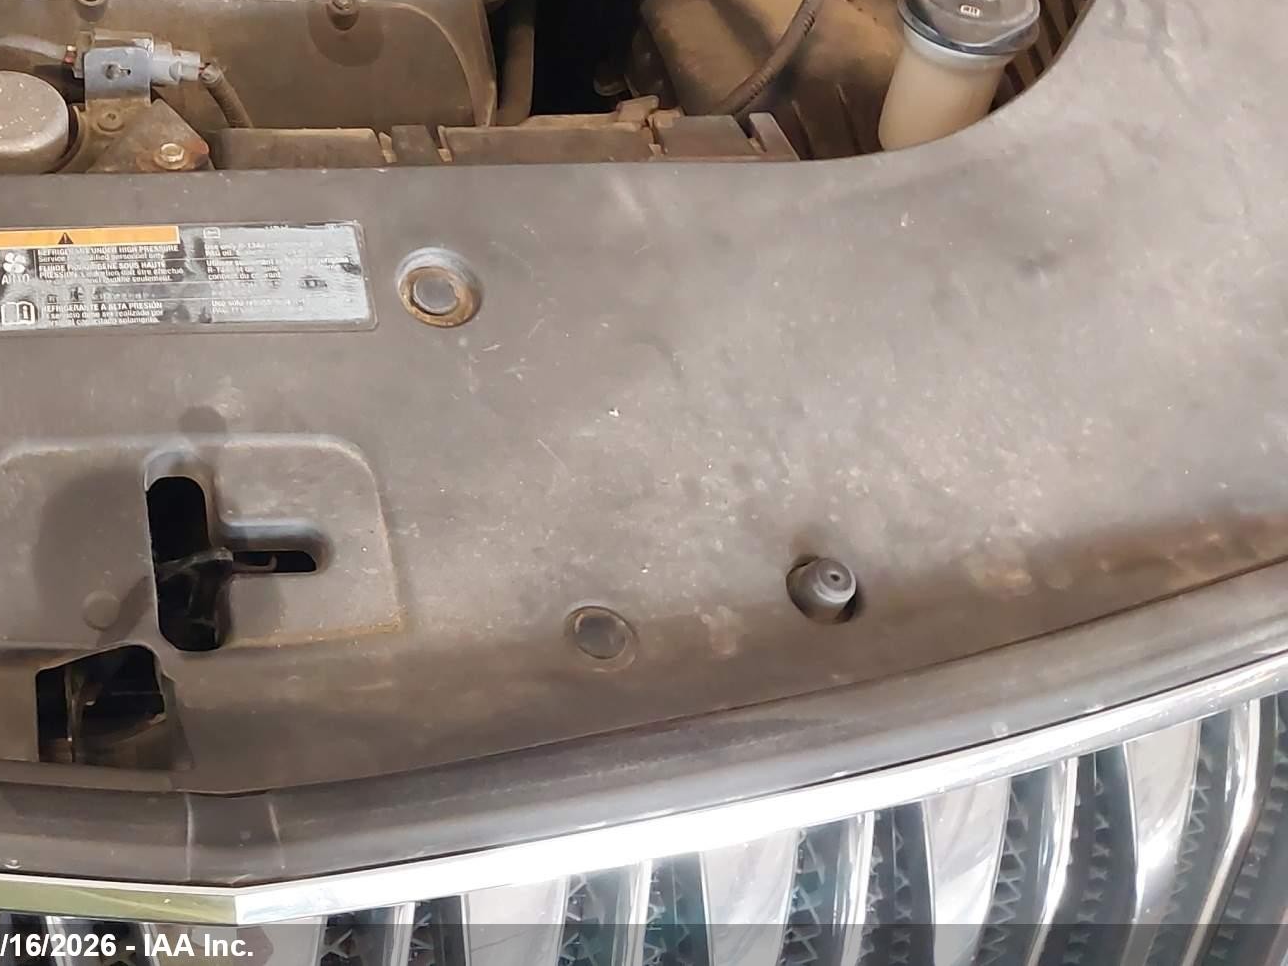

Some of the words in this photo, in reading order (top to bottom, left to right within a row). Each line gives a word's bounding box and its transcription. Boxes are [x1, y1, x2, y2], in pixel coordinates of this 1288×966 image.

[37, 247, 88, 256] REFRIGE
[119, 245, 137, 254] HIGH
[139, 244, 179, 254] PRESSURE
[38, 256, 66, 264] Service
[39, 264, 65, 272] FLUIDE
[119, 261, 139, 269] SOUS
[141, 260, 166, 269] HAUTE
